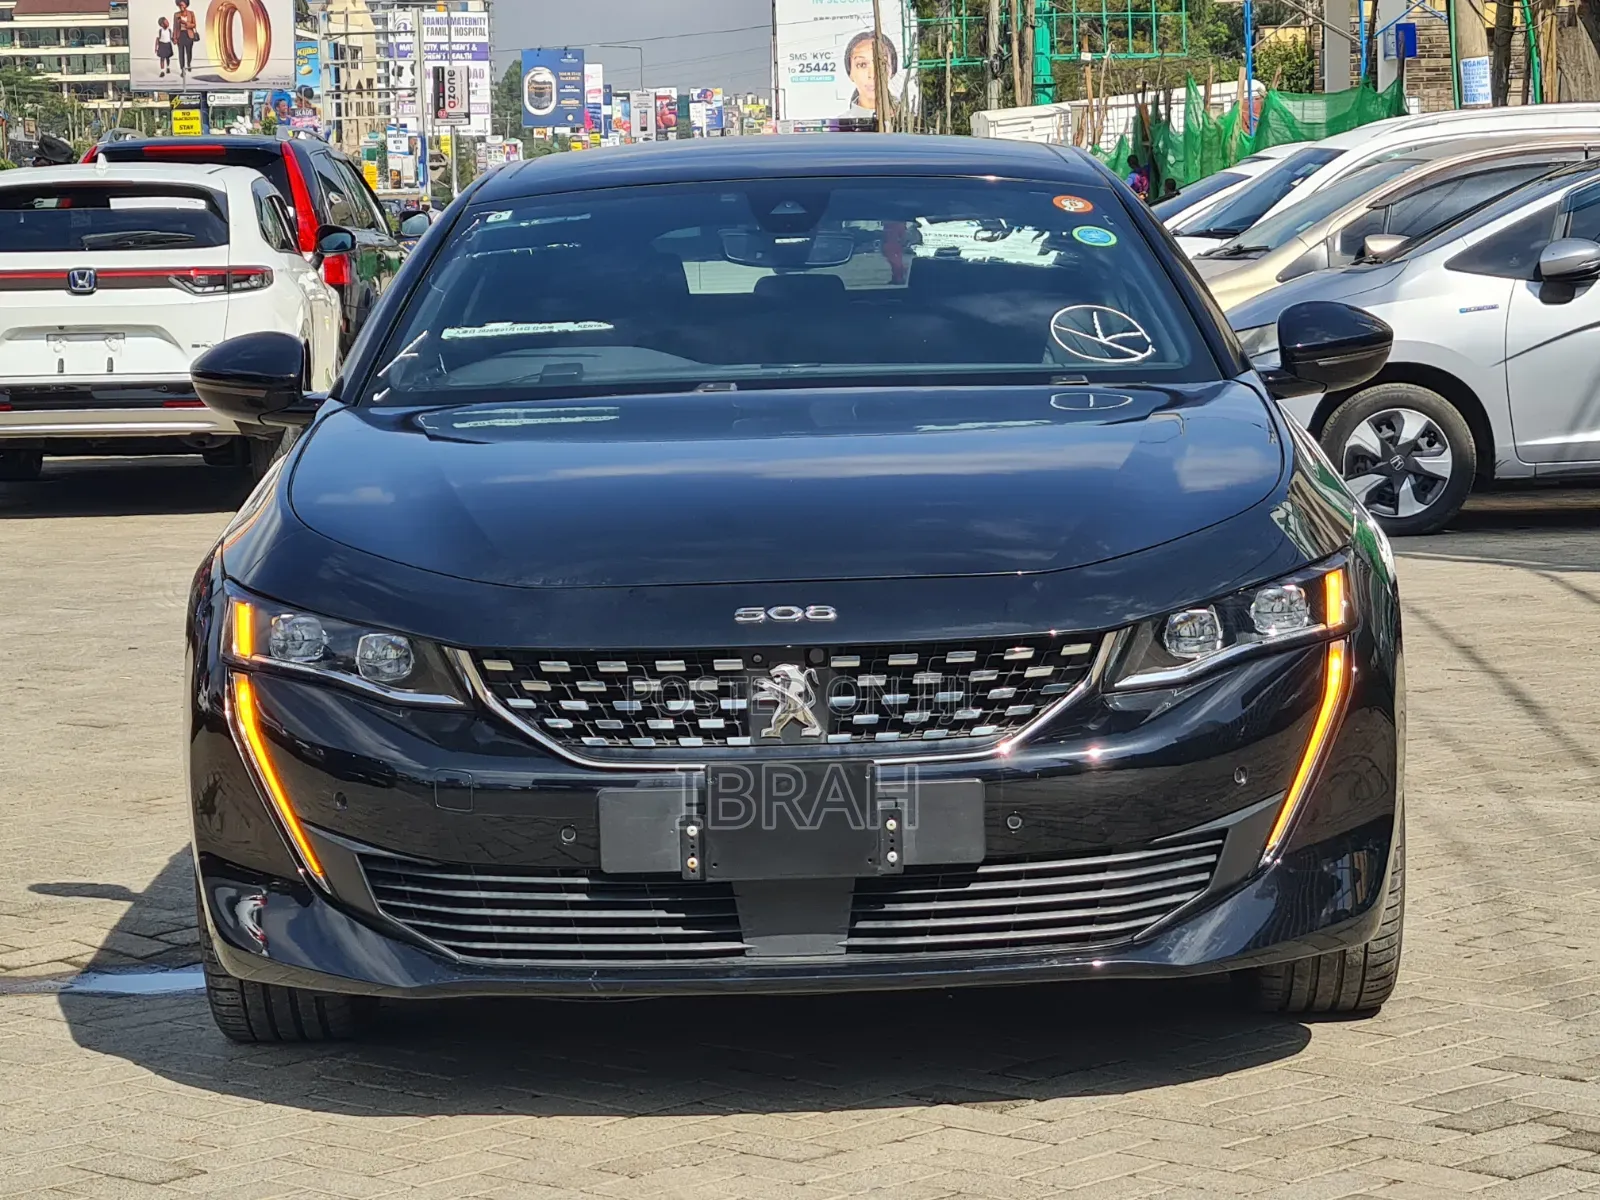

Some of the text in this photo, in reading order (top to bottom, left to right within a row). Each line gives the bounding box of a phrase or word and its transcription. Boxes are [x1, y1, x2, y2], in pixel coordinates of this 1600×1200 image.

[426, 27, 487, 37] FAMIL HOSPITAL
[789, 52, 808, 61] SMS
[798, 62, 836, 73] 25442
[447, 69, 456, 109] azone
[733, 604, 838, 623] 508
